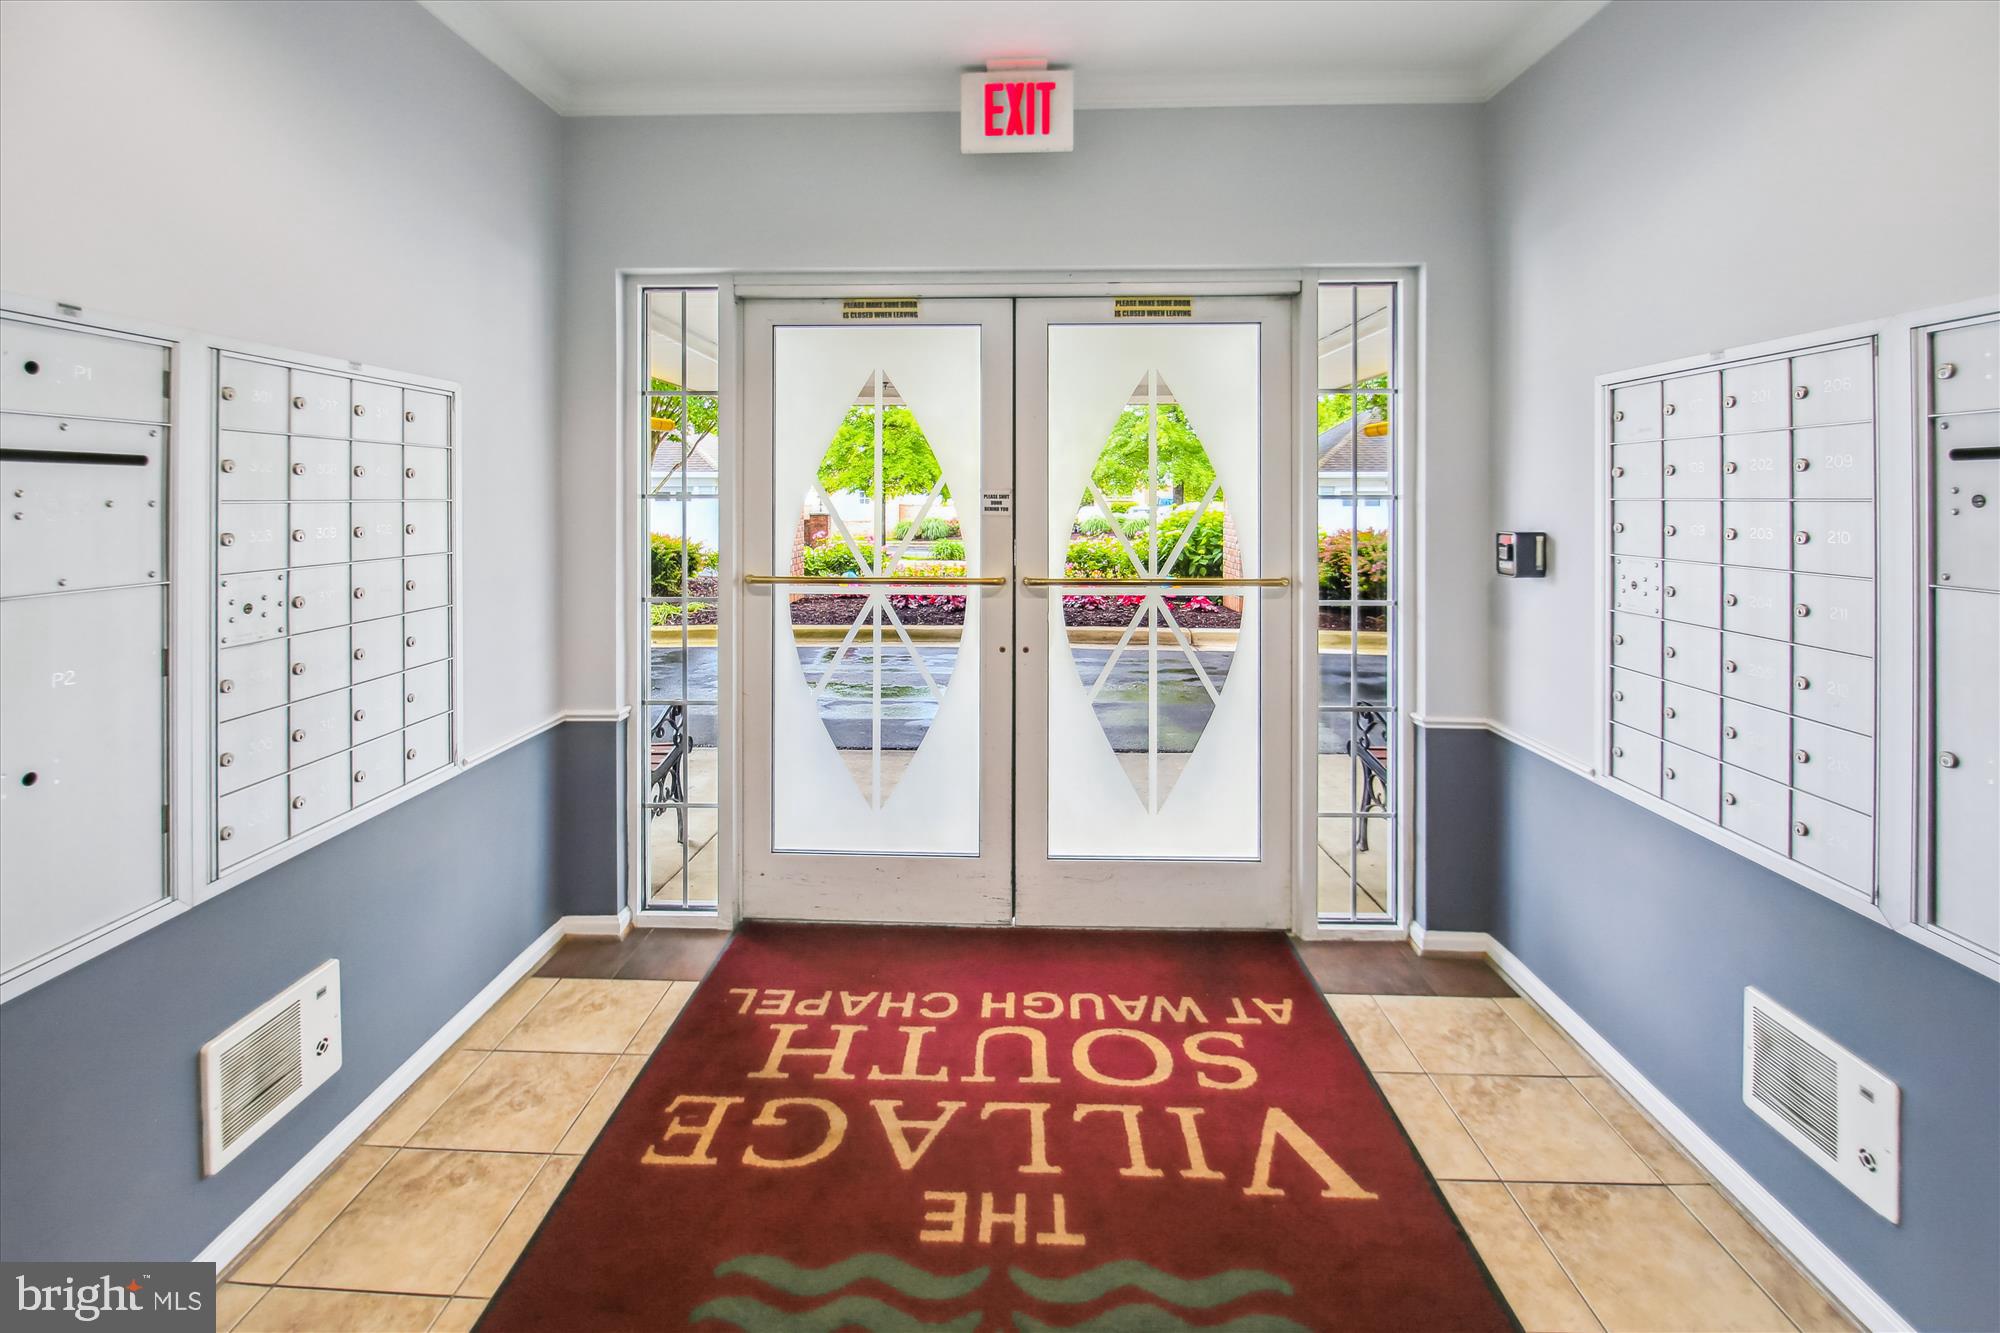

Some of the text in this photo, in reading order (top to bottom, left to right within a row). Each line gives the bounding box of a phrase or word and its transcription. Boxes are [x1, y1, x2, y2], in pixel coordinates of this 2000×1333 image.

[984, 82, 1056, 136] EXIT
[843, 301, 865, 309] PLEASE
[73, 364, 93, 381] P1
[1750, 388, 1771, 404] 201
[1749, 458, 1774, 472] 202
[1824, 454, 1853, 470] 209
[1749, 526, 1774, 541] 203
[1826, 530, 1852, 545] 210
[1829, 606, 1849, 621] 211
[51, 668, 77, 688] P2
[728, 987, 1294, 1026] AT WAUGH CHAPEL
[746, 1023, 1259, 1090] SOUTH
[640, 1094, 1380, 1200] VILLAGE
[919, 1190, 1086, 1246] THE
